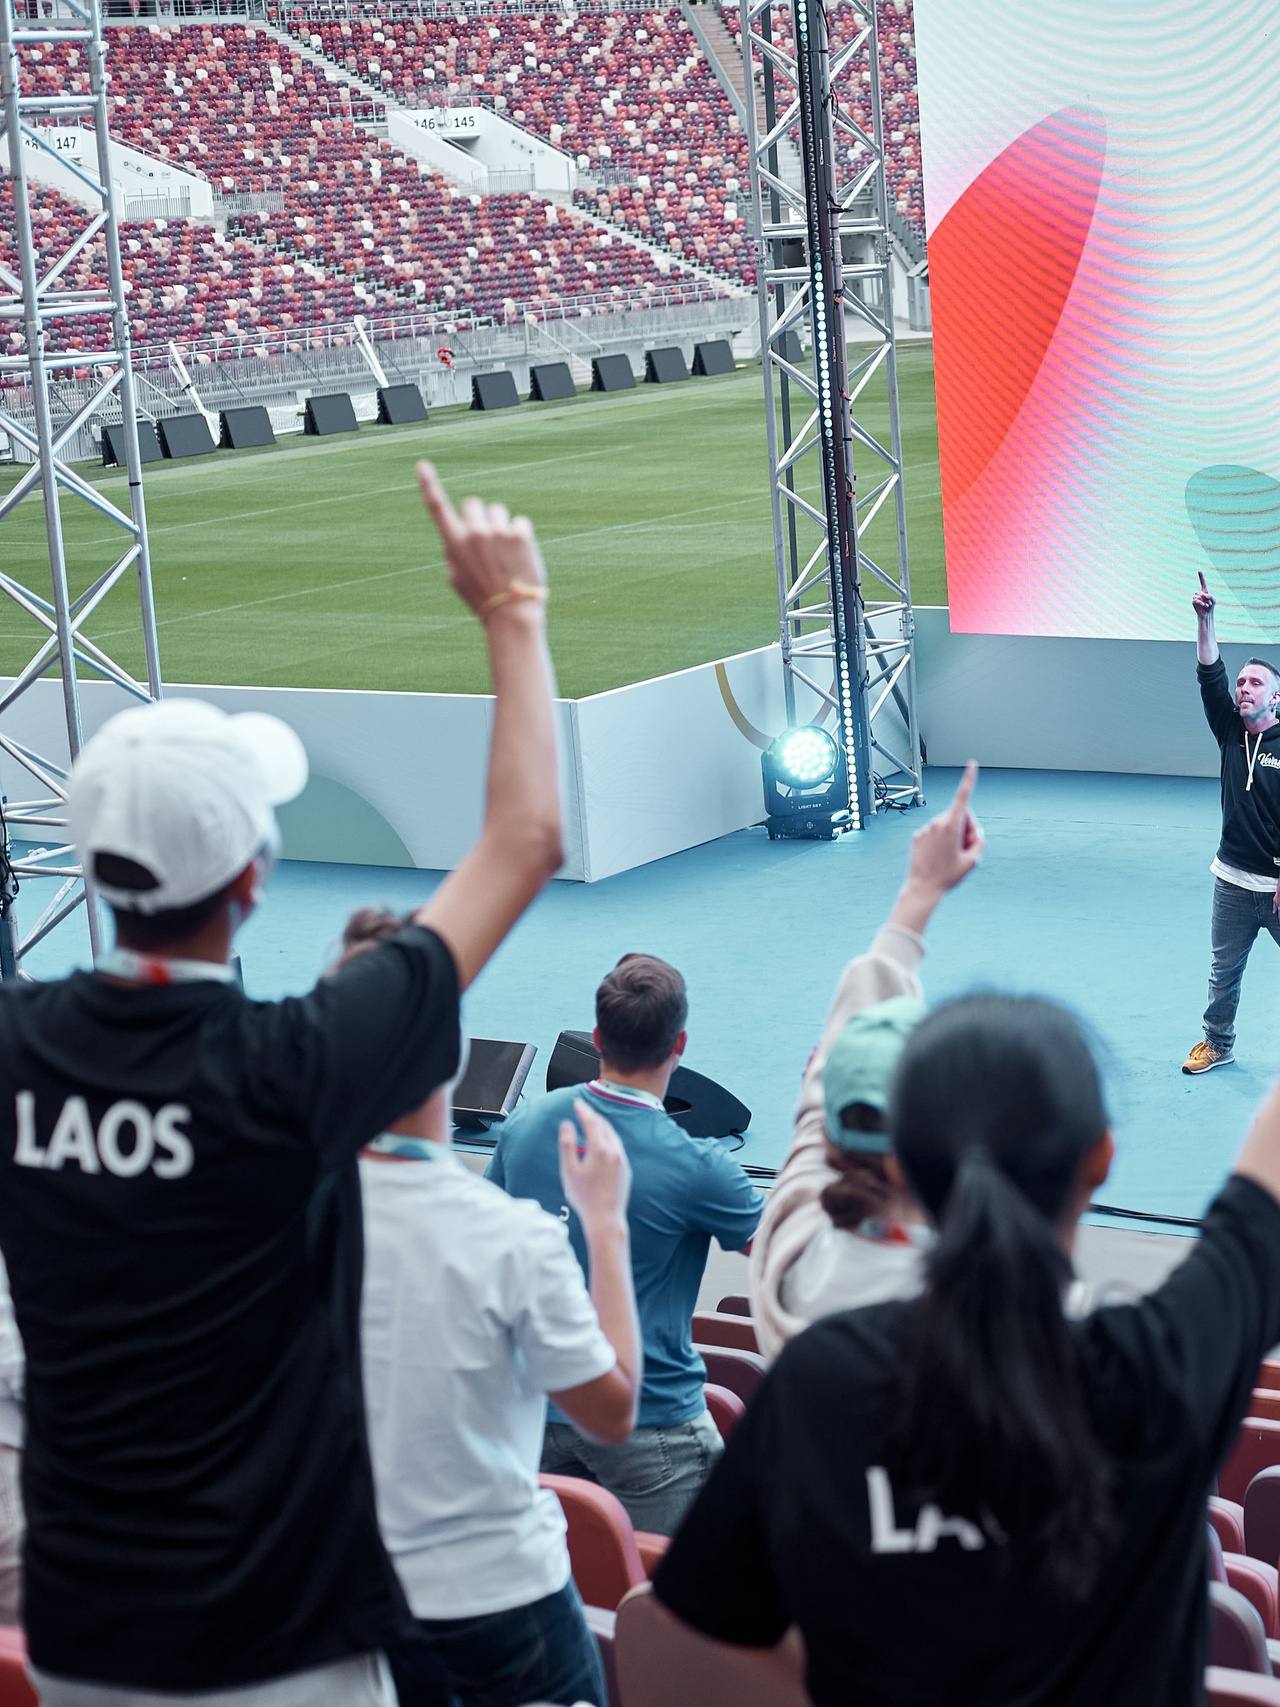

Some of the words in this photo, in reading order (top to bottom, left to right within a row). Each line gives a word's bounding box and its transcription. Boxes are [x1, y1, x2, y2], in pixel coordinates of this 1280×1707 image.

[454, 116, 475, 128] 145
[56, 136, 77, 149] 147
[13, 1088, 195, 1180] LAOS
